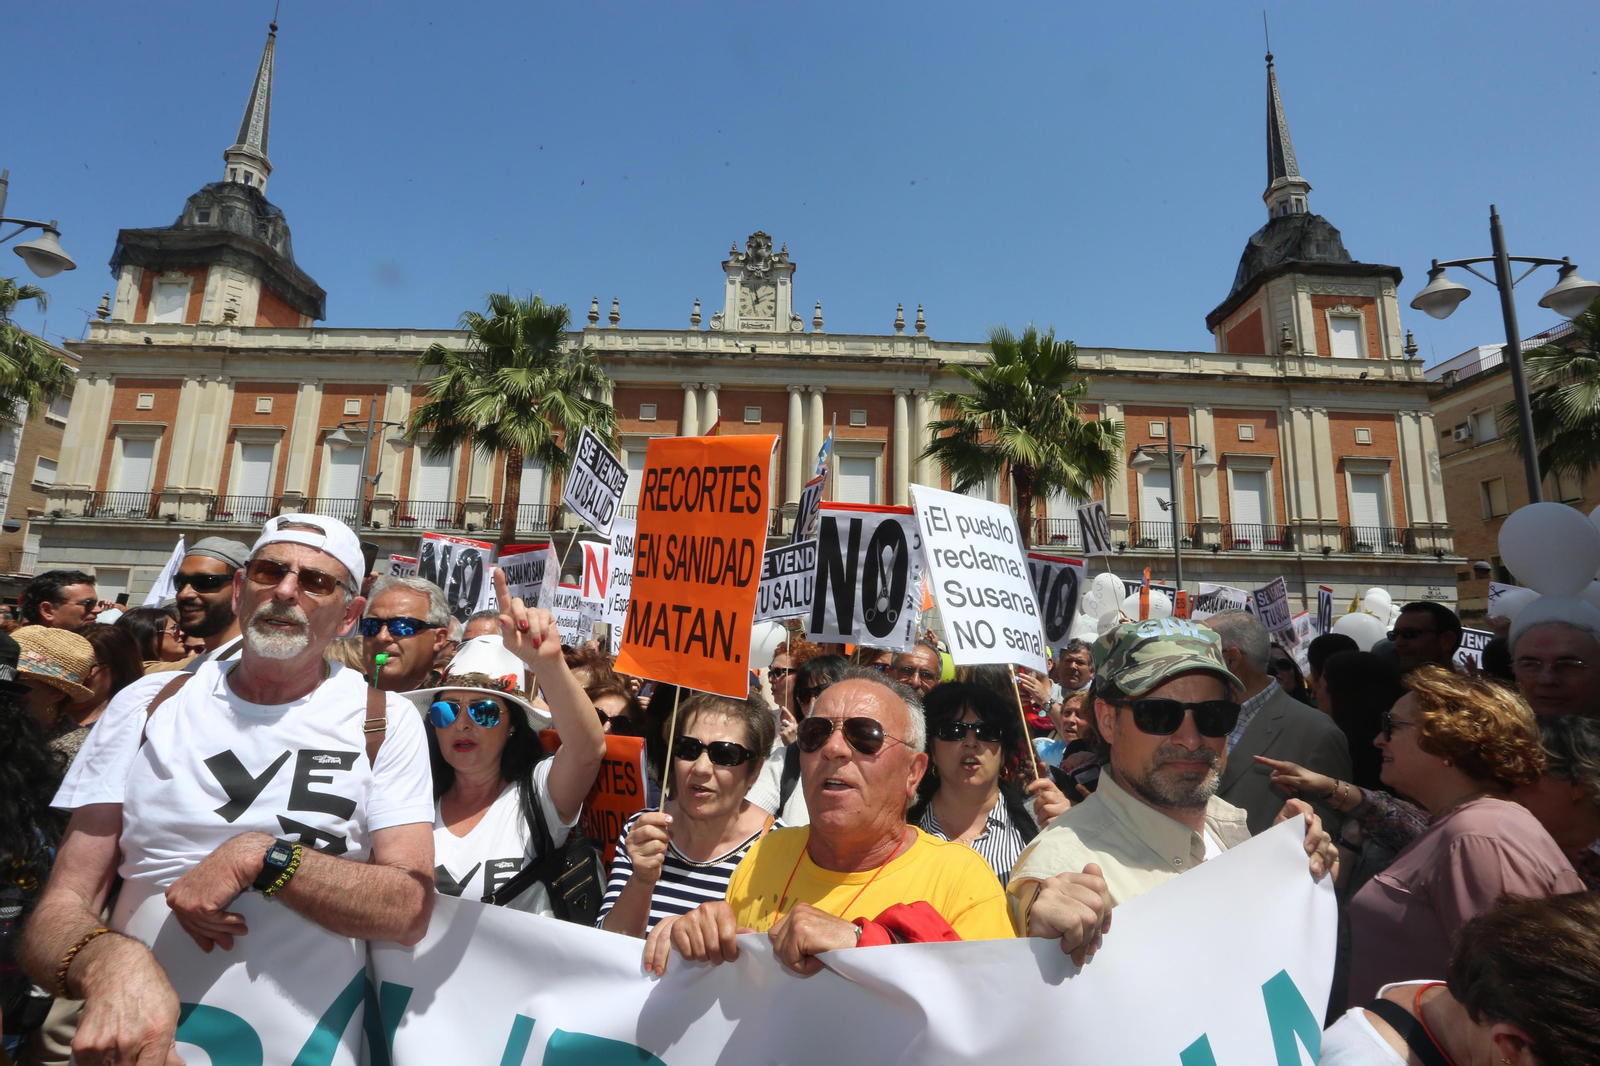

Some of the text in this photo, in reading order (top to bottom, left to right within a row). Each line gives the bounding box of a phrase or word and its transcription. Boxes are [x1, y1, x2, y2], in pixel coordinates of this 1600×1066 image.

[581, 436, 626, 496] SE VENDE
[570, 465, 615, 526] TU SALUD
[642, 464, 761, 514] RECORTES
[924, 505, 1014, 545] ¡El pueblo
[1077, 504, 1112, 553] NO
[635, 533, 755, 588] EN SANIDAD
[775, 546, 815, 575] VEND
[810, 516, 909, 639] NO
[933, 545, 1026, 581] reclama:
[418, 542, 484, 625] NO
[607, 596, 614, 615] y
[772, 576, 813, 611] SALU
[943, 579, 1037, 617] Susana
[625, 599, 741, 664] MATAN.
[953, 619, 1044, 658] NO sana!
[592, 760, 638, 797] TES
